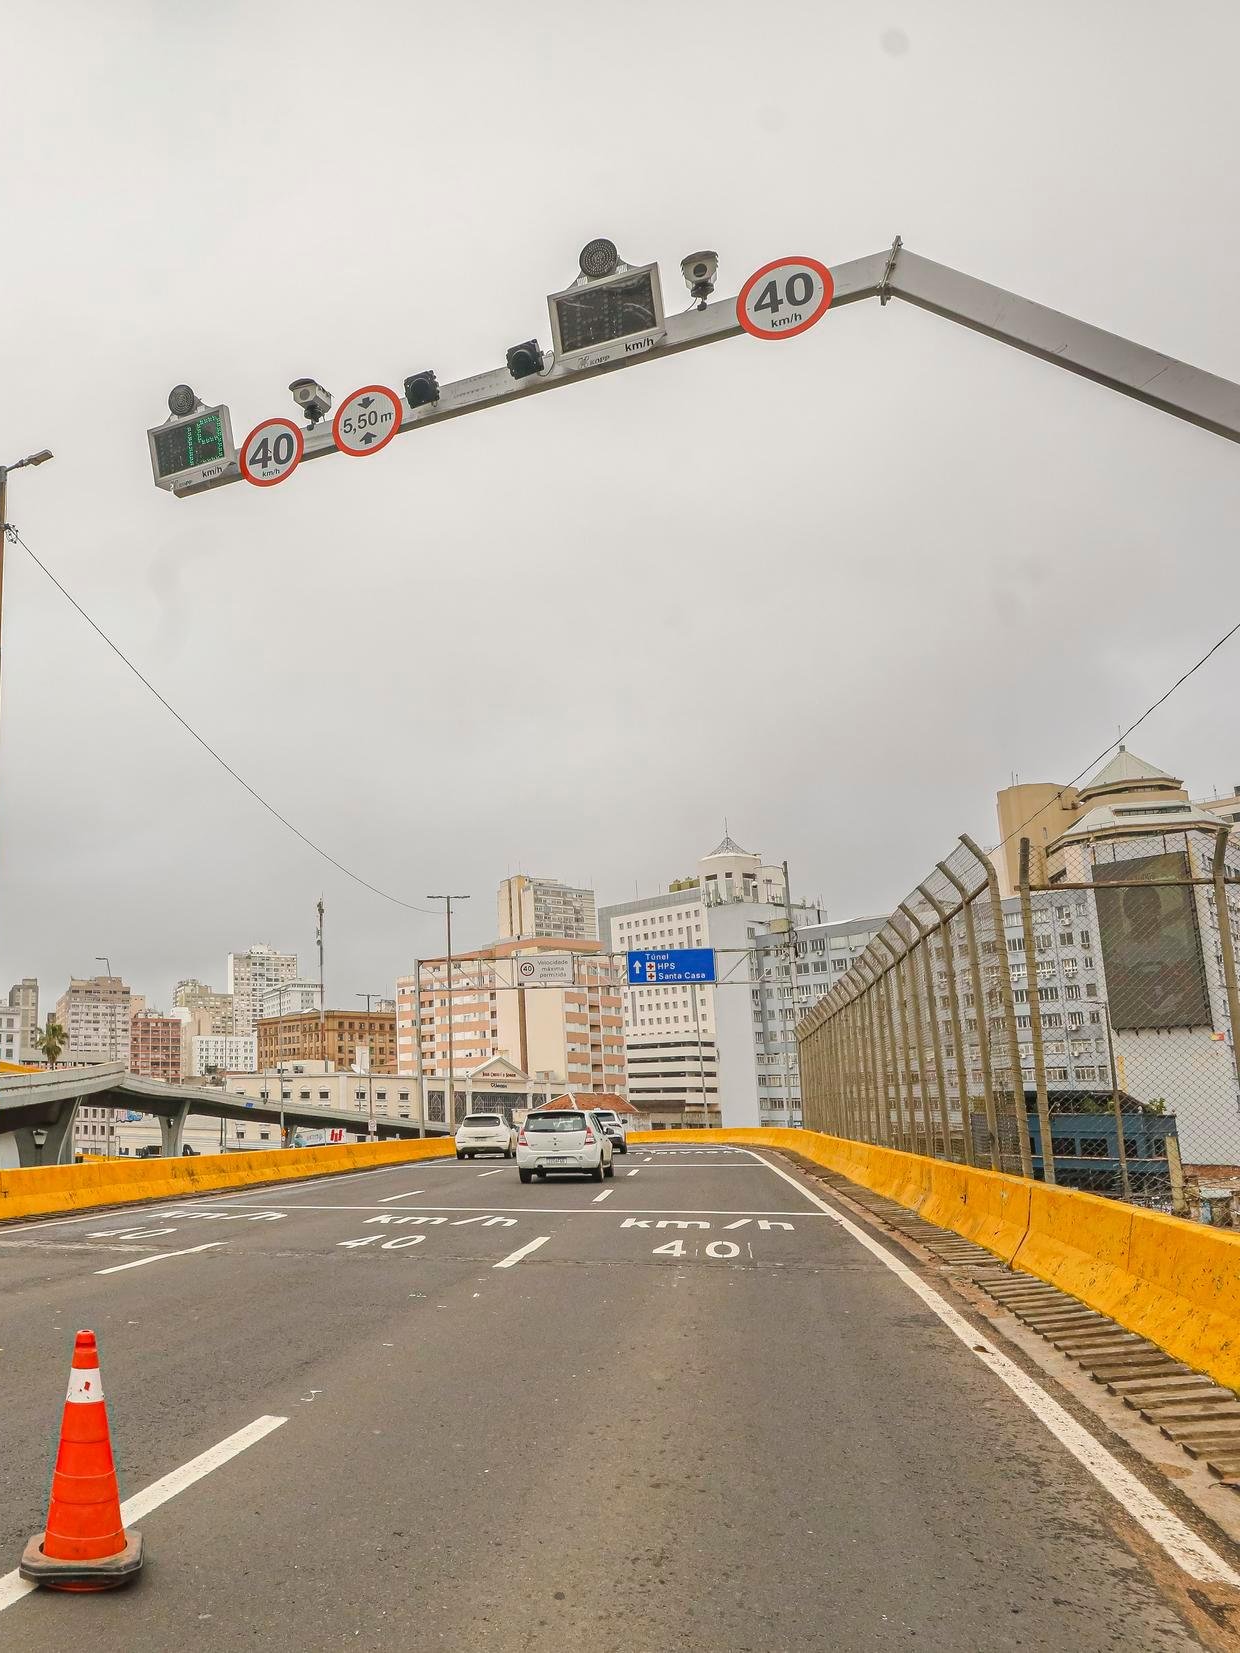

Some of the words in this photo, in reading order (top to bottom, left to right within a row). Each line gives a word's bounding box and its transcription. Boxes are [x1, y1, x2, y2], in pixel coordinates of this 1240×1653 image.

[753, 272, 815, 314] 40
[771, 312, 803, 328] km/h
[625, 337, 654, 352] km/h
[342, 410, 378, 433] 5,50
[380, 412, 392, 423] m
[249, 433, 294, 469] 40
[202, 467, 222, 478] km/h
[262, 468, 280, 477] km/h
[657, 962, 676, 970] HPS
[148, 1210, 287, 1221] km/h
[363, 1214, 519, 1226] km/h
[620, 1218, 796, 1230] km/h
[86, 1226, 178, 1240] 40
[336, 1234, 426, 1250] 40
[652, 1240, 741, 1259] 40
